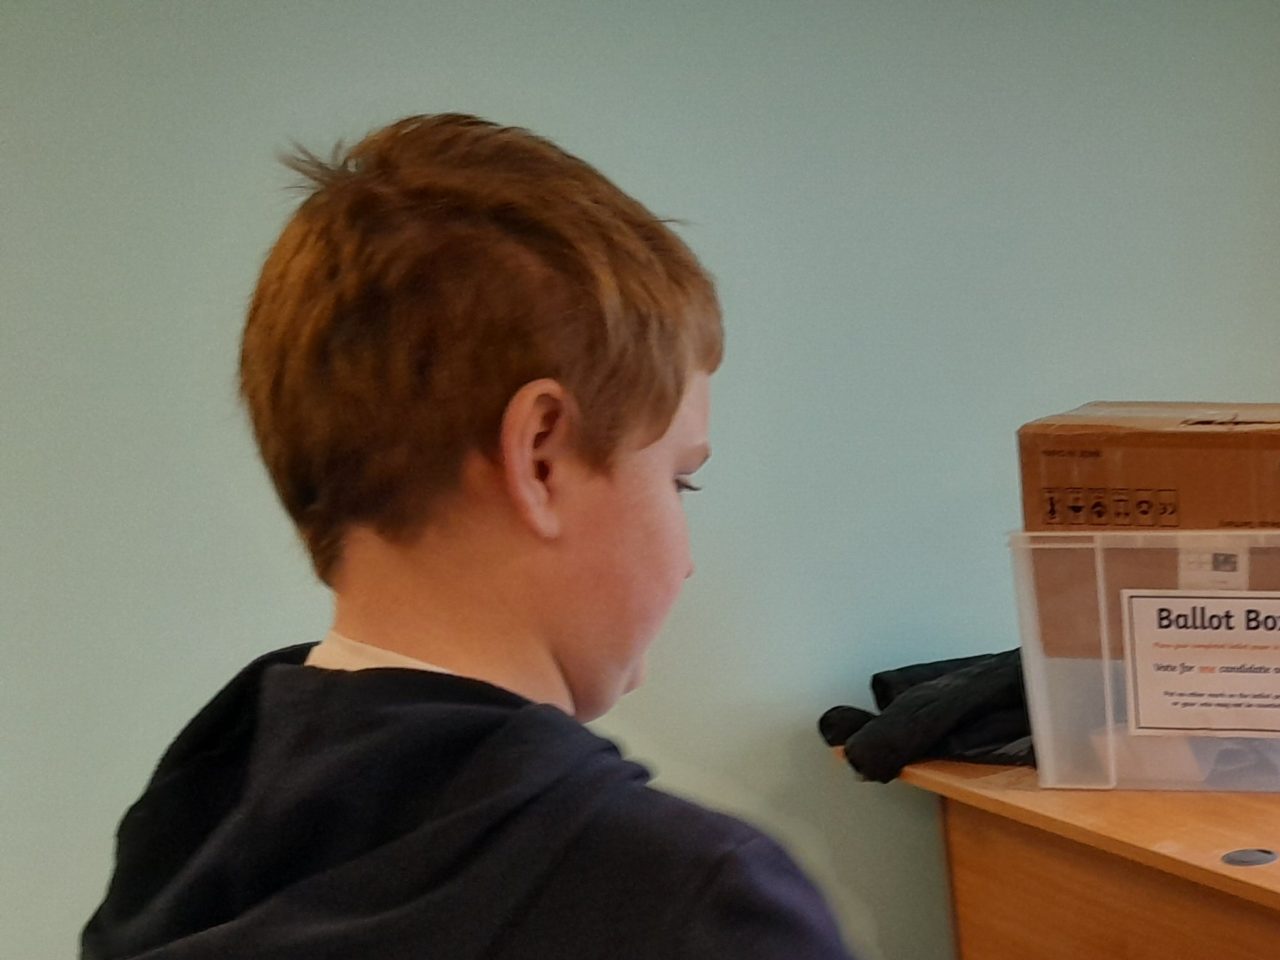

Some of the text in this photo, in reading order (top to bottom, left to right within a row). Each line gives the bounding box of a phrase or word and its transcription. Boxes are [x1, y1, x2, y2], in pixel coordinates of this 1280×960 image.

[1157, 606, 1235, 630] Ballot
[1179, 662, 1195, 675] for
[1219, 663, 1271, 674] candidate
